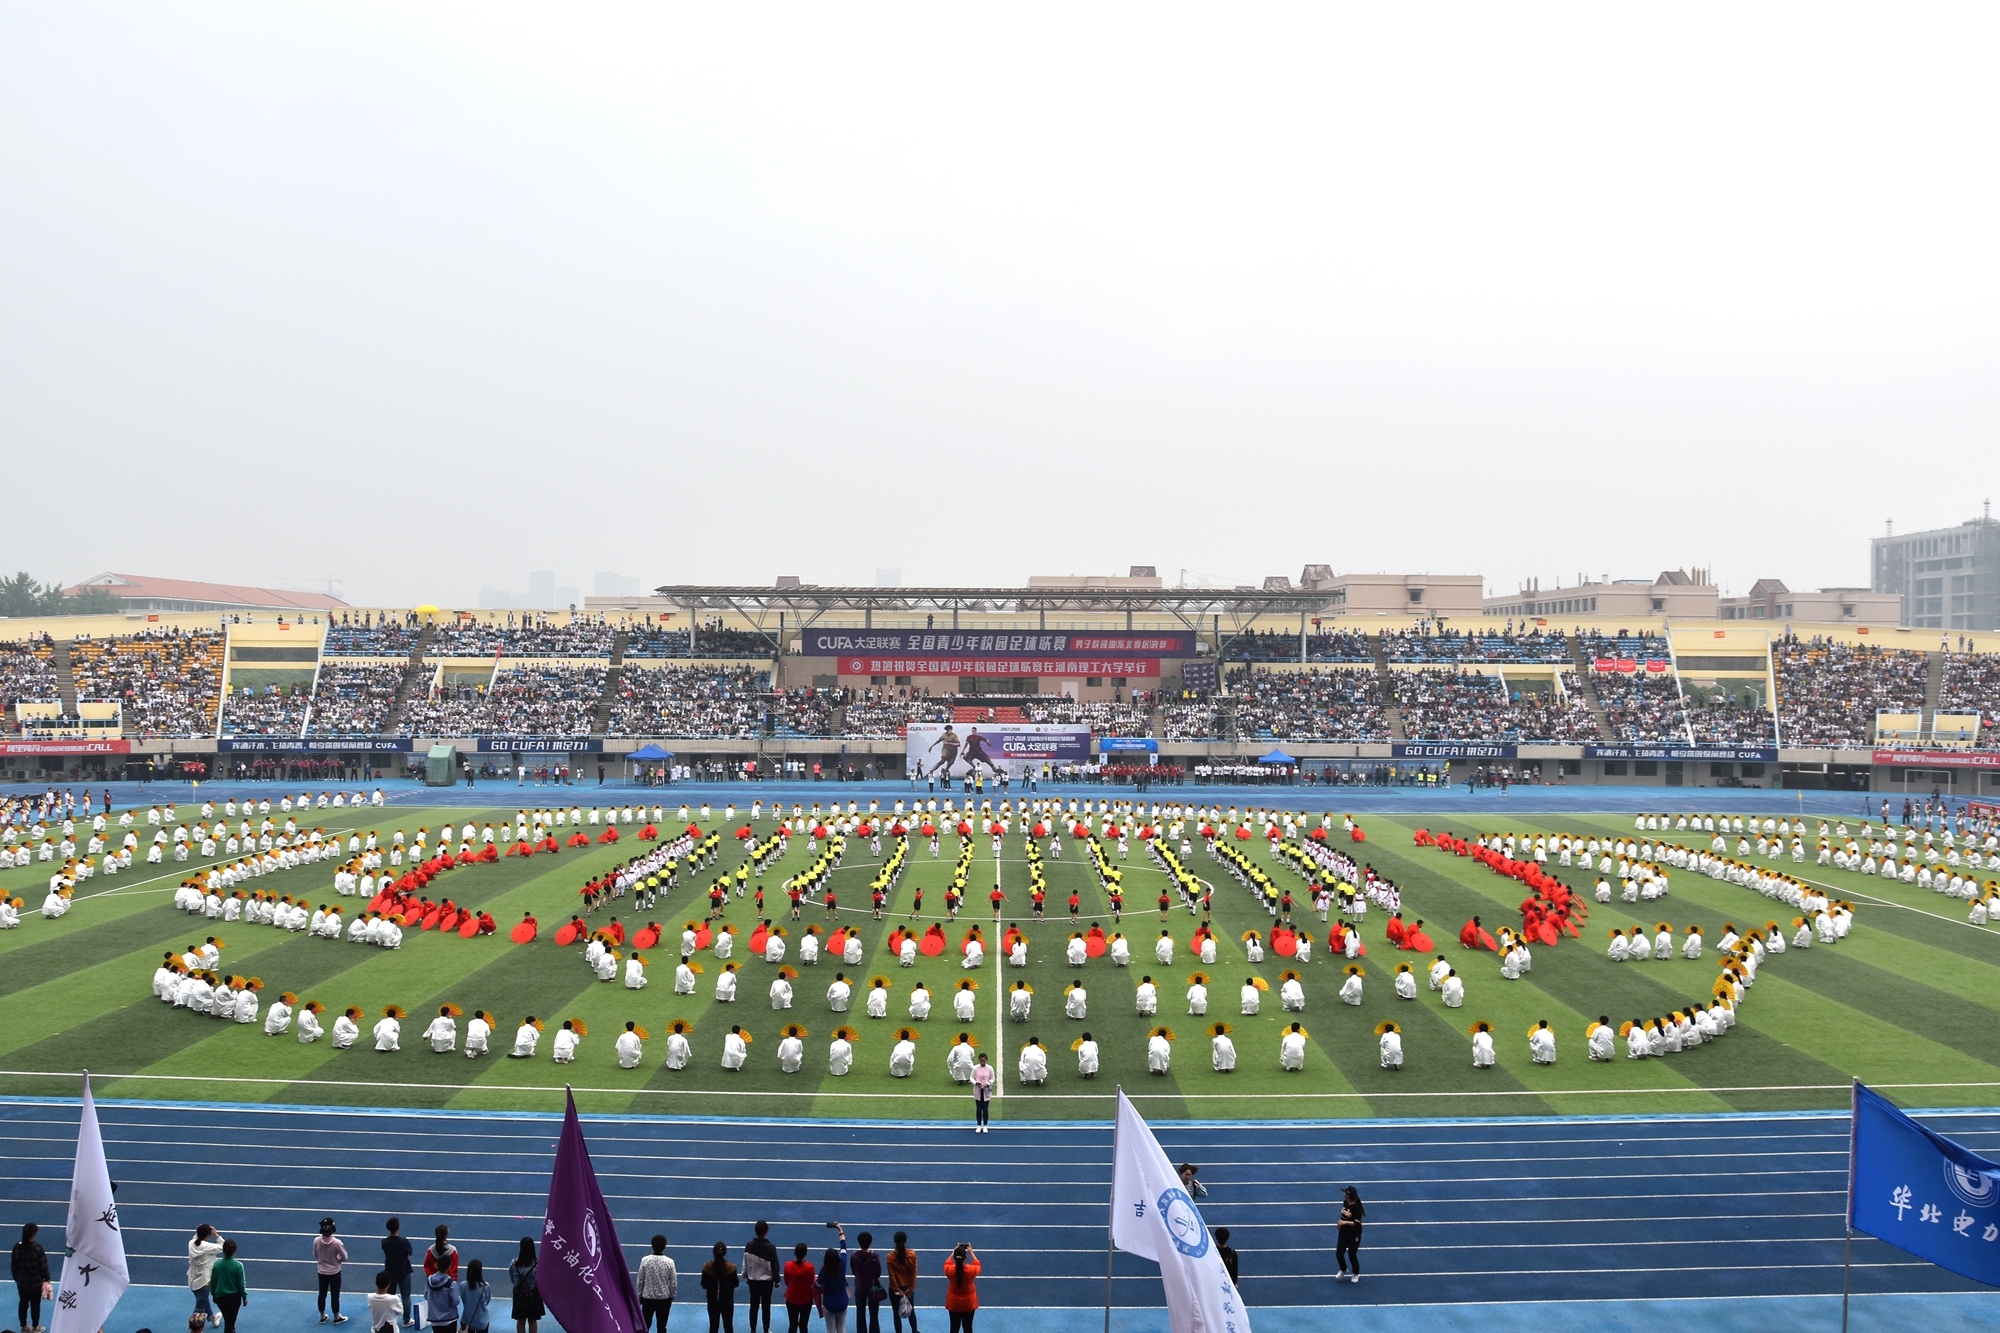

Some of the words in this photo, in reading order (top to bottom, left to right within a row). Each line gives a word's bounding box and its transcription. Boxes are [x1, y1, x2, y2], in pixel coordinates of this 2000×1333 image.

[907, 635, 1067, 651] 全国青少年校园足球联赛
[871, 660, 1147, 673] 热烈祝贺全国青少年校园足球联赛在河南理工大学举行
[491, 741, 508, 750] GO
[511, 741, 550, 750] CUFA!
[1405, 746, 1422, 755] GO
[1426, 746, 1464, 756] CUFA!
[1738, 751, 1762, 759] CUFA
[1889, 1184, 1999, 1242] 华北电力
